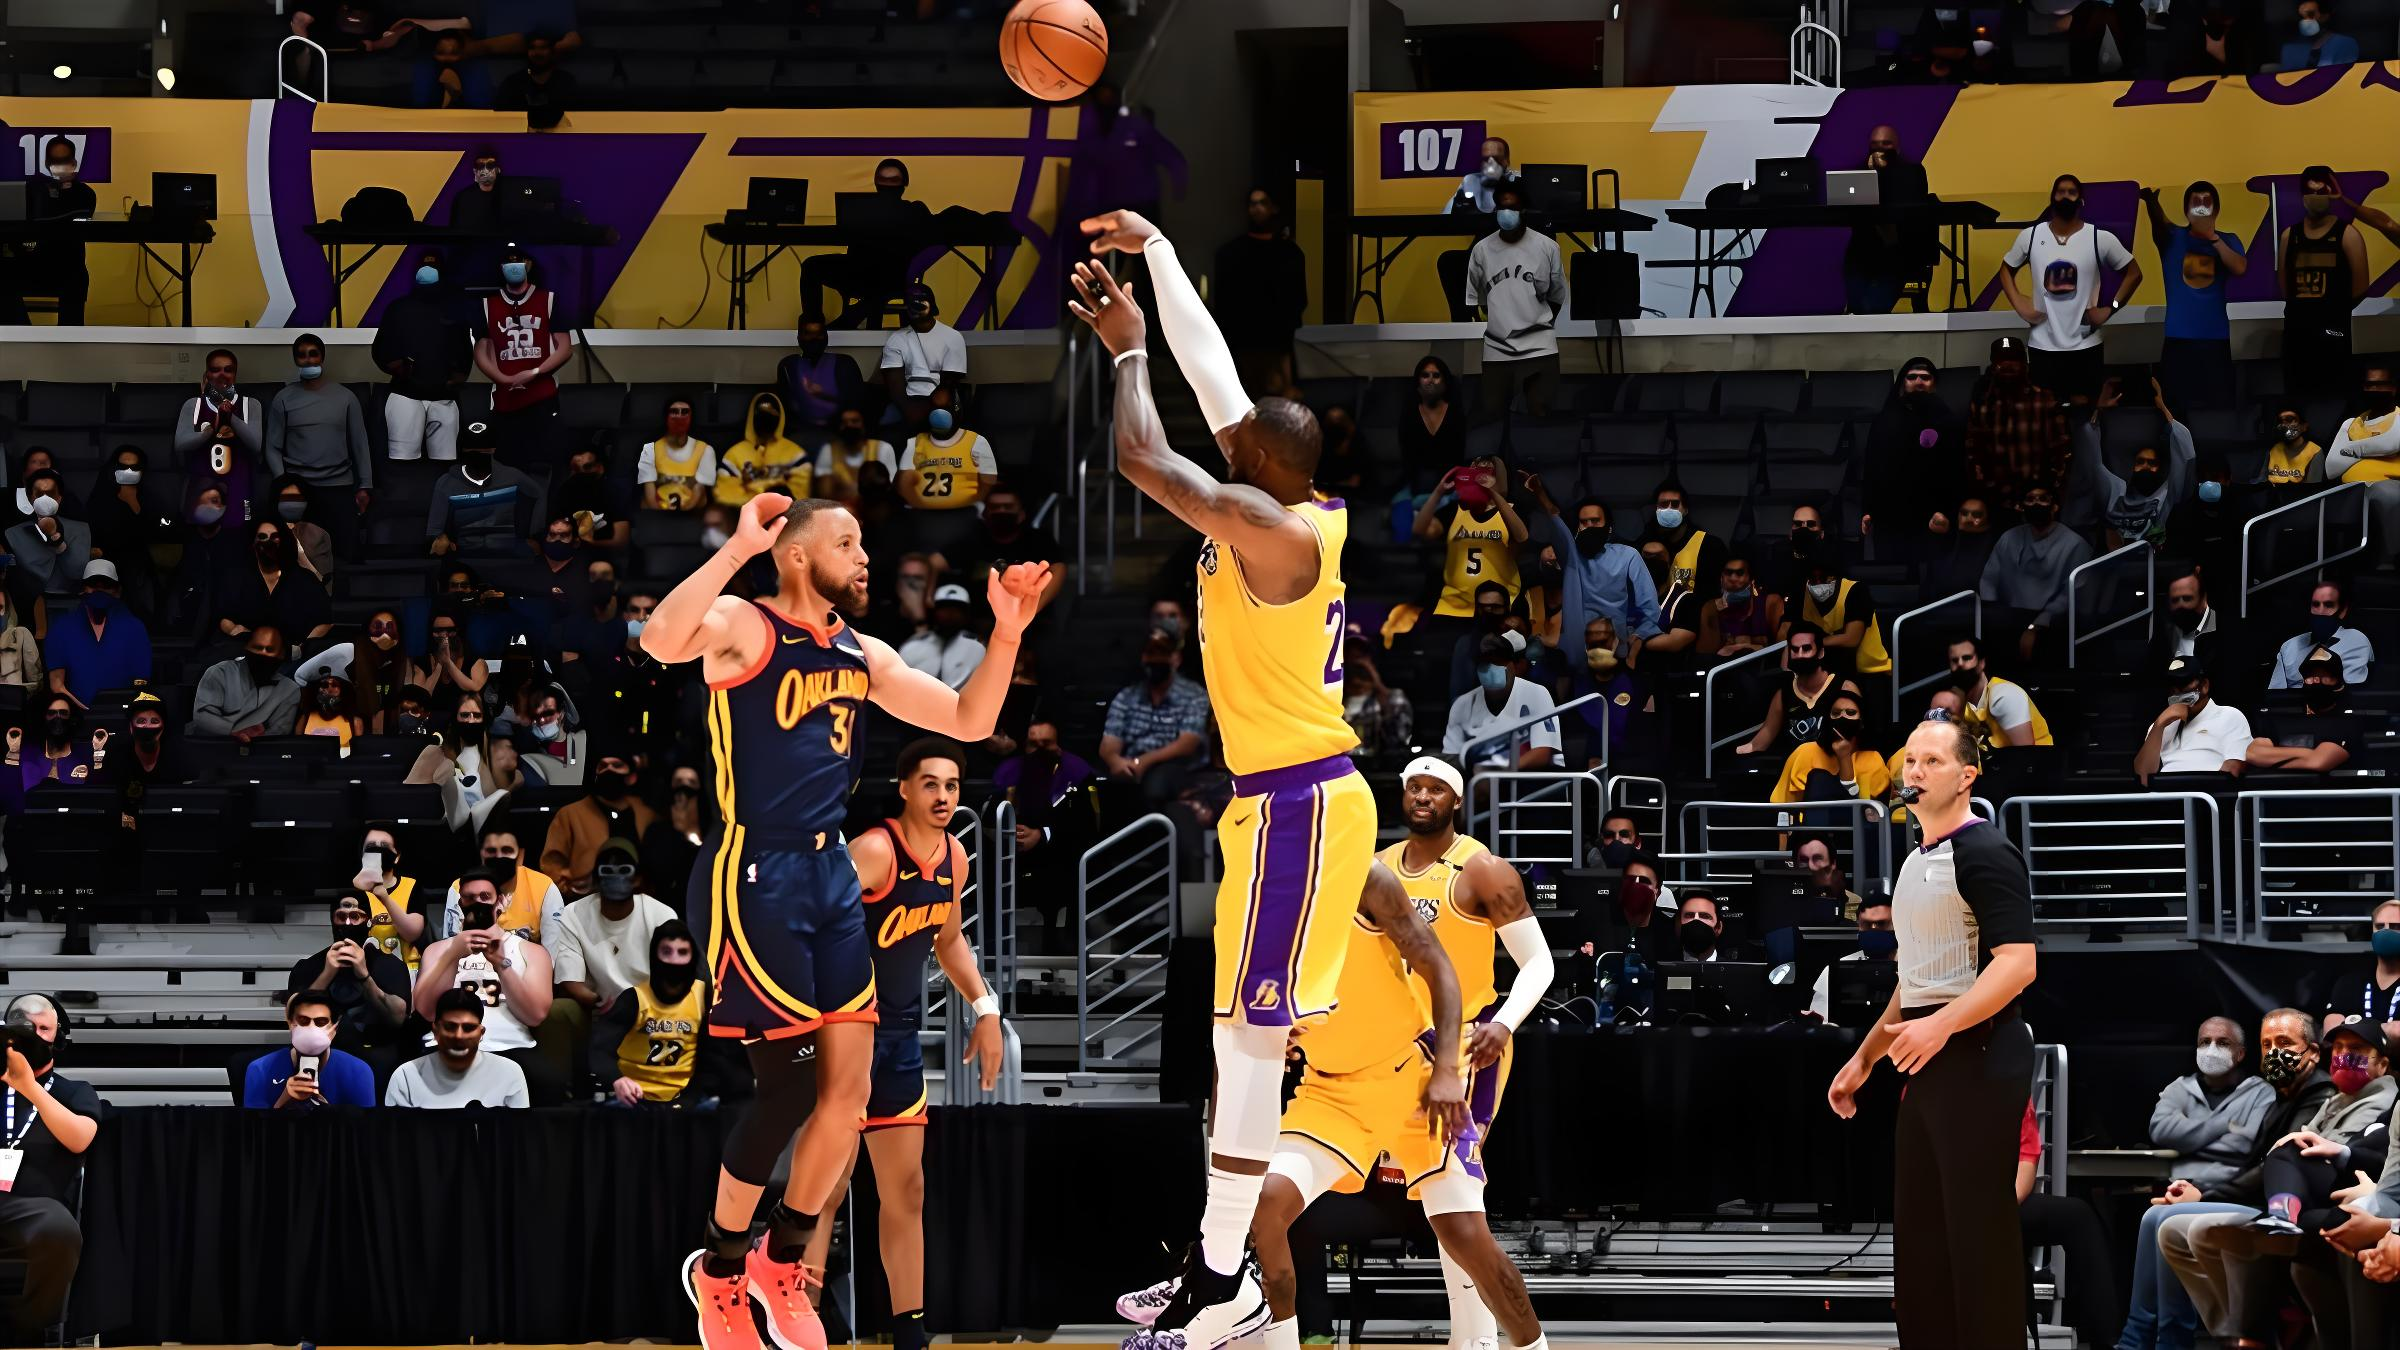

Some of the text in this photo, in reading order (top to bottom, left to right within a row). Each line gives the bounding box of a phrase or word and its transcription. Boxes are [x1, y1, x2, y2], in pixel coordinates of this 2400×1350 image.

[1398, 128, 1463, 171] 107
[211, 443, 232, 475] 8
[922, 471, 954, 497] 23
[1466, 547, 1482, 577] 5
